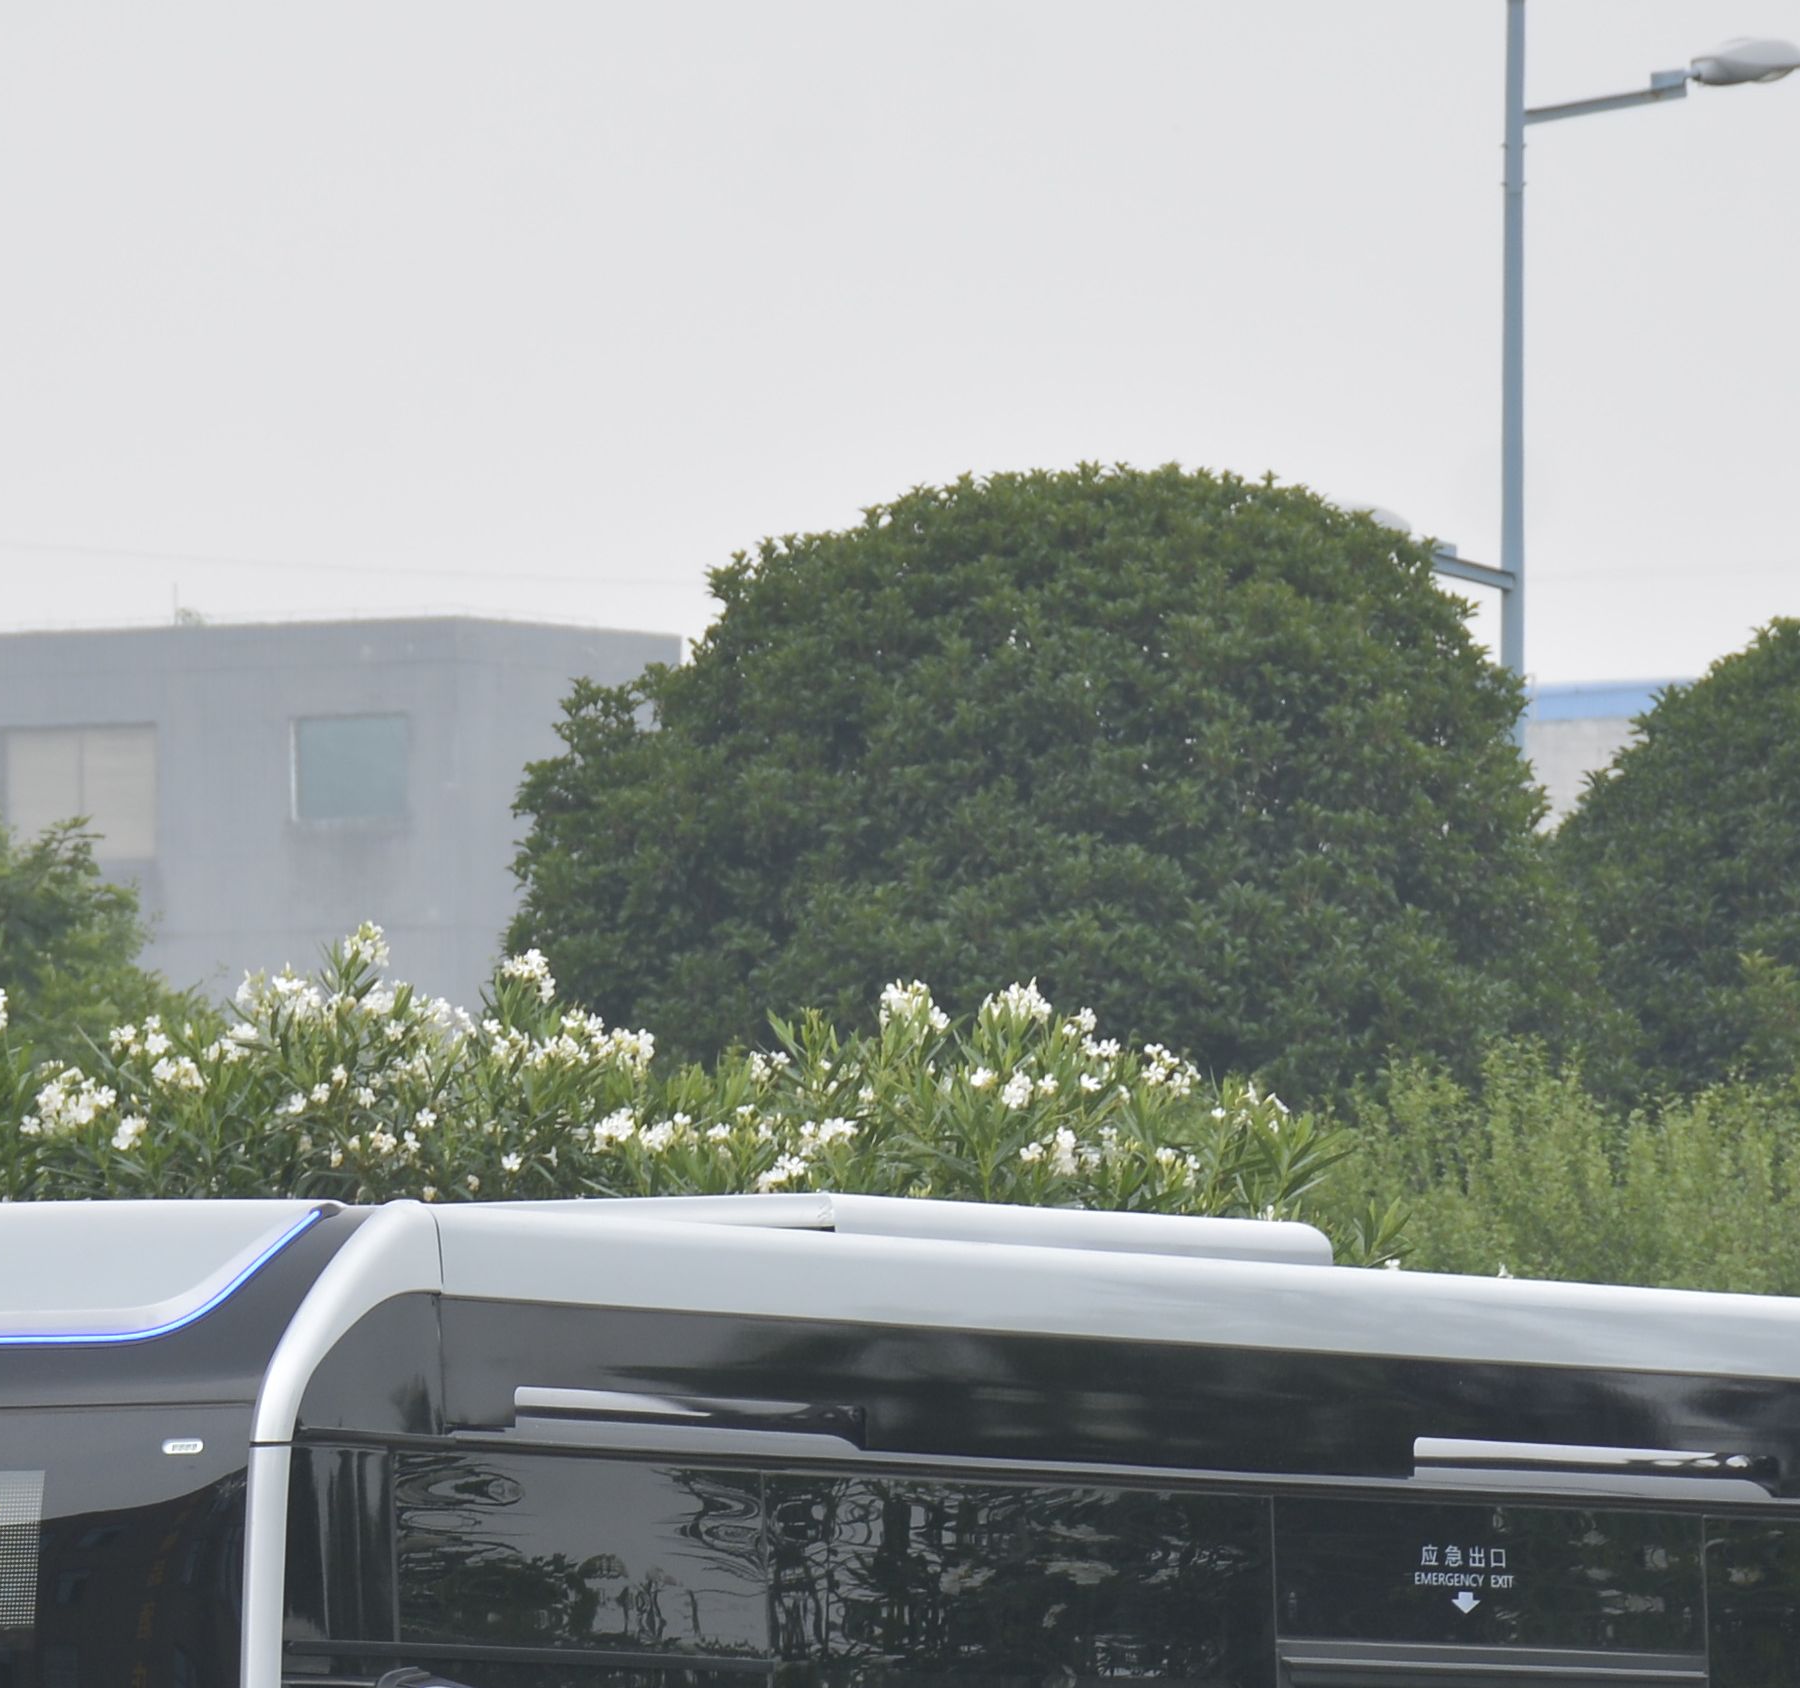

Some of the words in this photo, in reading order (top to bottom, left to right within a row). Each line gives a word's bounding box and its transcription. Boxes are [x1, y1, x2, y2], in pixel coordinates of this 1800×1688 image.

[1421, 1544, 1506, 1568] 应急出口
[1414, 1572, 1485, 1587] EMERGENCY
[1490, 1575, 1514, 1589] EXIT
